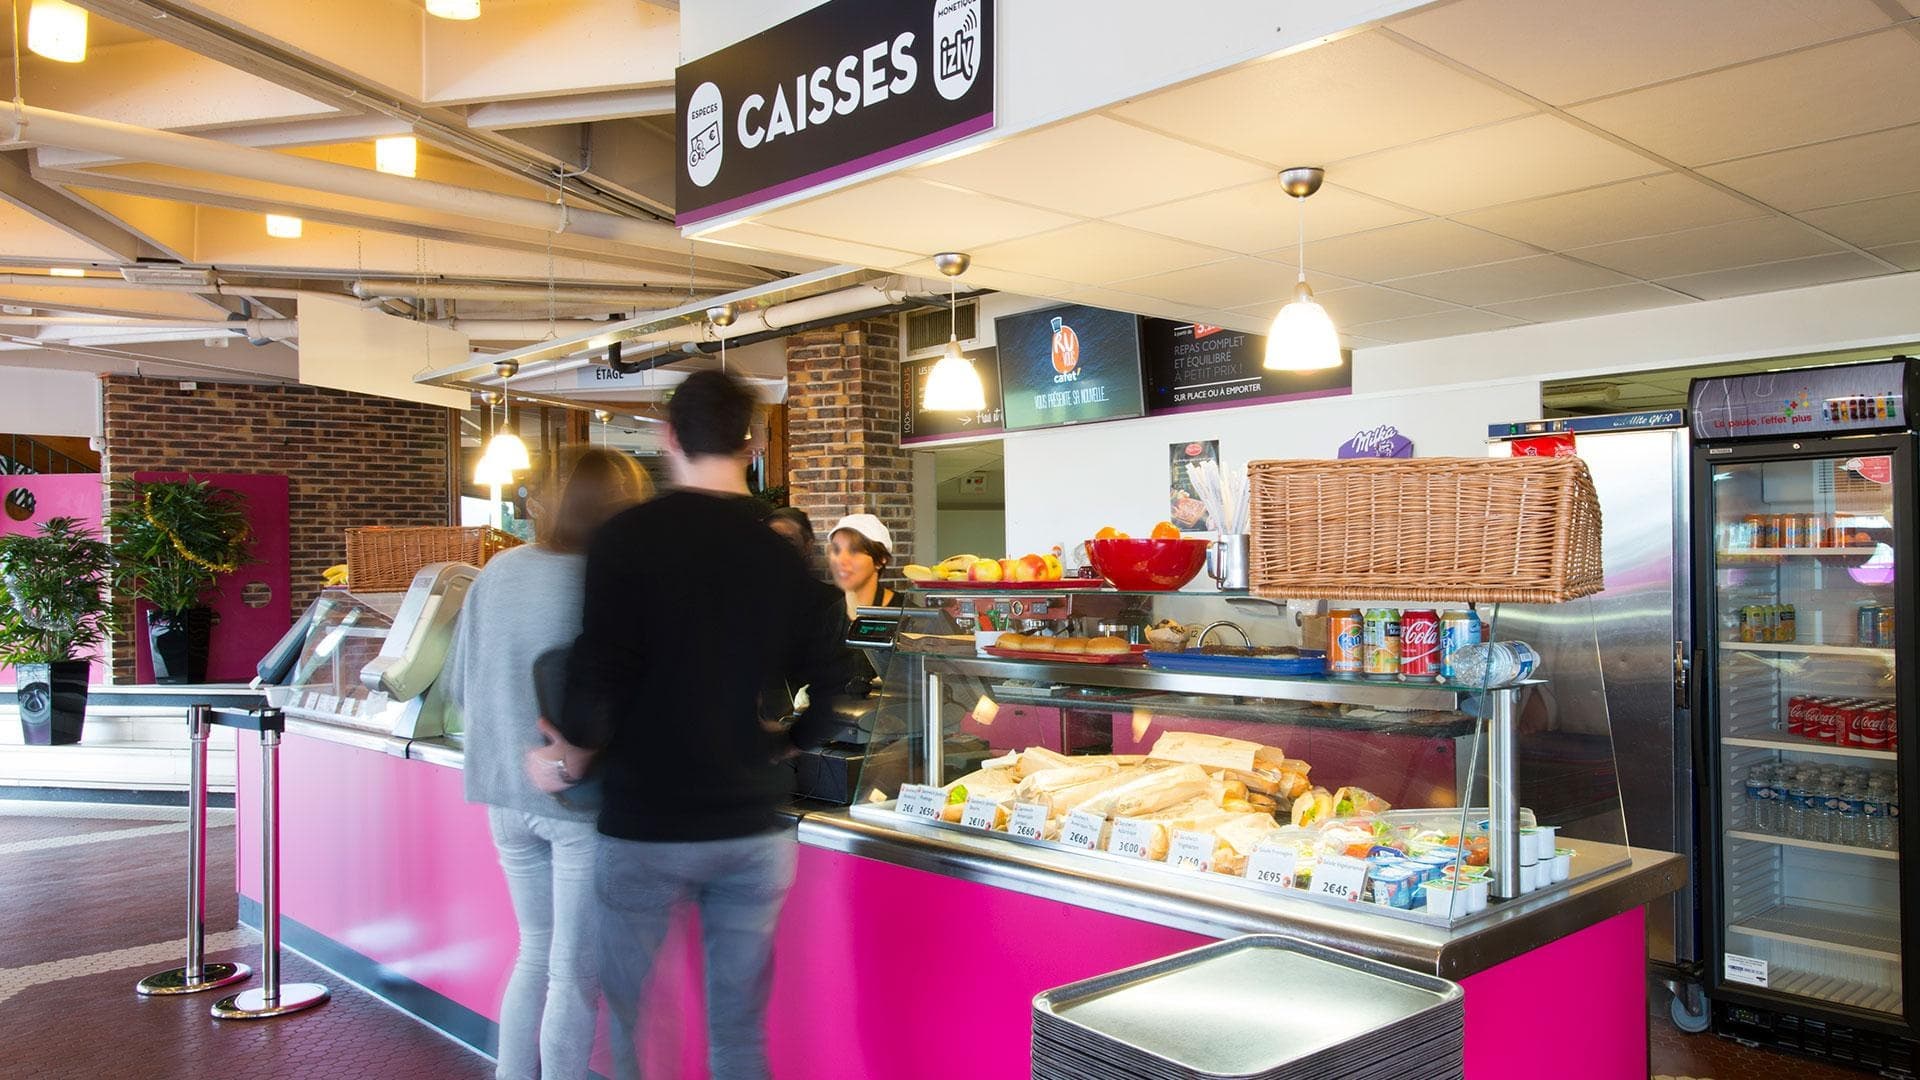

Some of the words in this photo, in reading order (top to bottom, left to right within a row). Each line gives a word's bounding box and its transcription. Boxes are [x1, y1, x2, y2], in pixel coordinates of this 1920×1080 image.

[940, 29, 974, 81] izly
[737, 32, 918, 150] CAISSES
[691, 103, 718, 120] ESPECES
[1174, 342, 1200, 356] REPAS
[1202, 335, 1245, 352] COMPLET
[1174, 358, 1185, 369] ET
[1184, 367, 1211, 381] PETIT
[1213, 364, 1237, 377] PRIX
[1174, 393, 1187, 402] SUR
[1187, 390, 1207, 400] PLACE
[1207, 389, 1219, 398] OU
[1219, 386, 1226, 396] À
[1226, 383, 1262, 396] EMPORTER
[1713, 419, 1725, 429] La
[1761, 414, 1786, 425] l'effet
[1791, 413, 1812, 425] plus
[1351, 424, 1397, 454] Milka
[1405, 620, 1438, 645] Cola
[919, 806, 935, 817] 2€50
[968, 816, 985, 828] 2€10
[1017, 825, 1035, 837] 2€60
[1069, 831, 1089, 845] 2€60
[1119, 841, 1139, 854] 3€00
[1257, 870, 1281, 884] 2€95
[1322, 882, 1349, 897] 2€45
